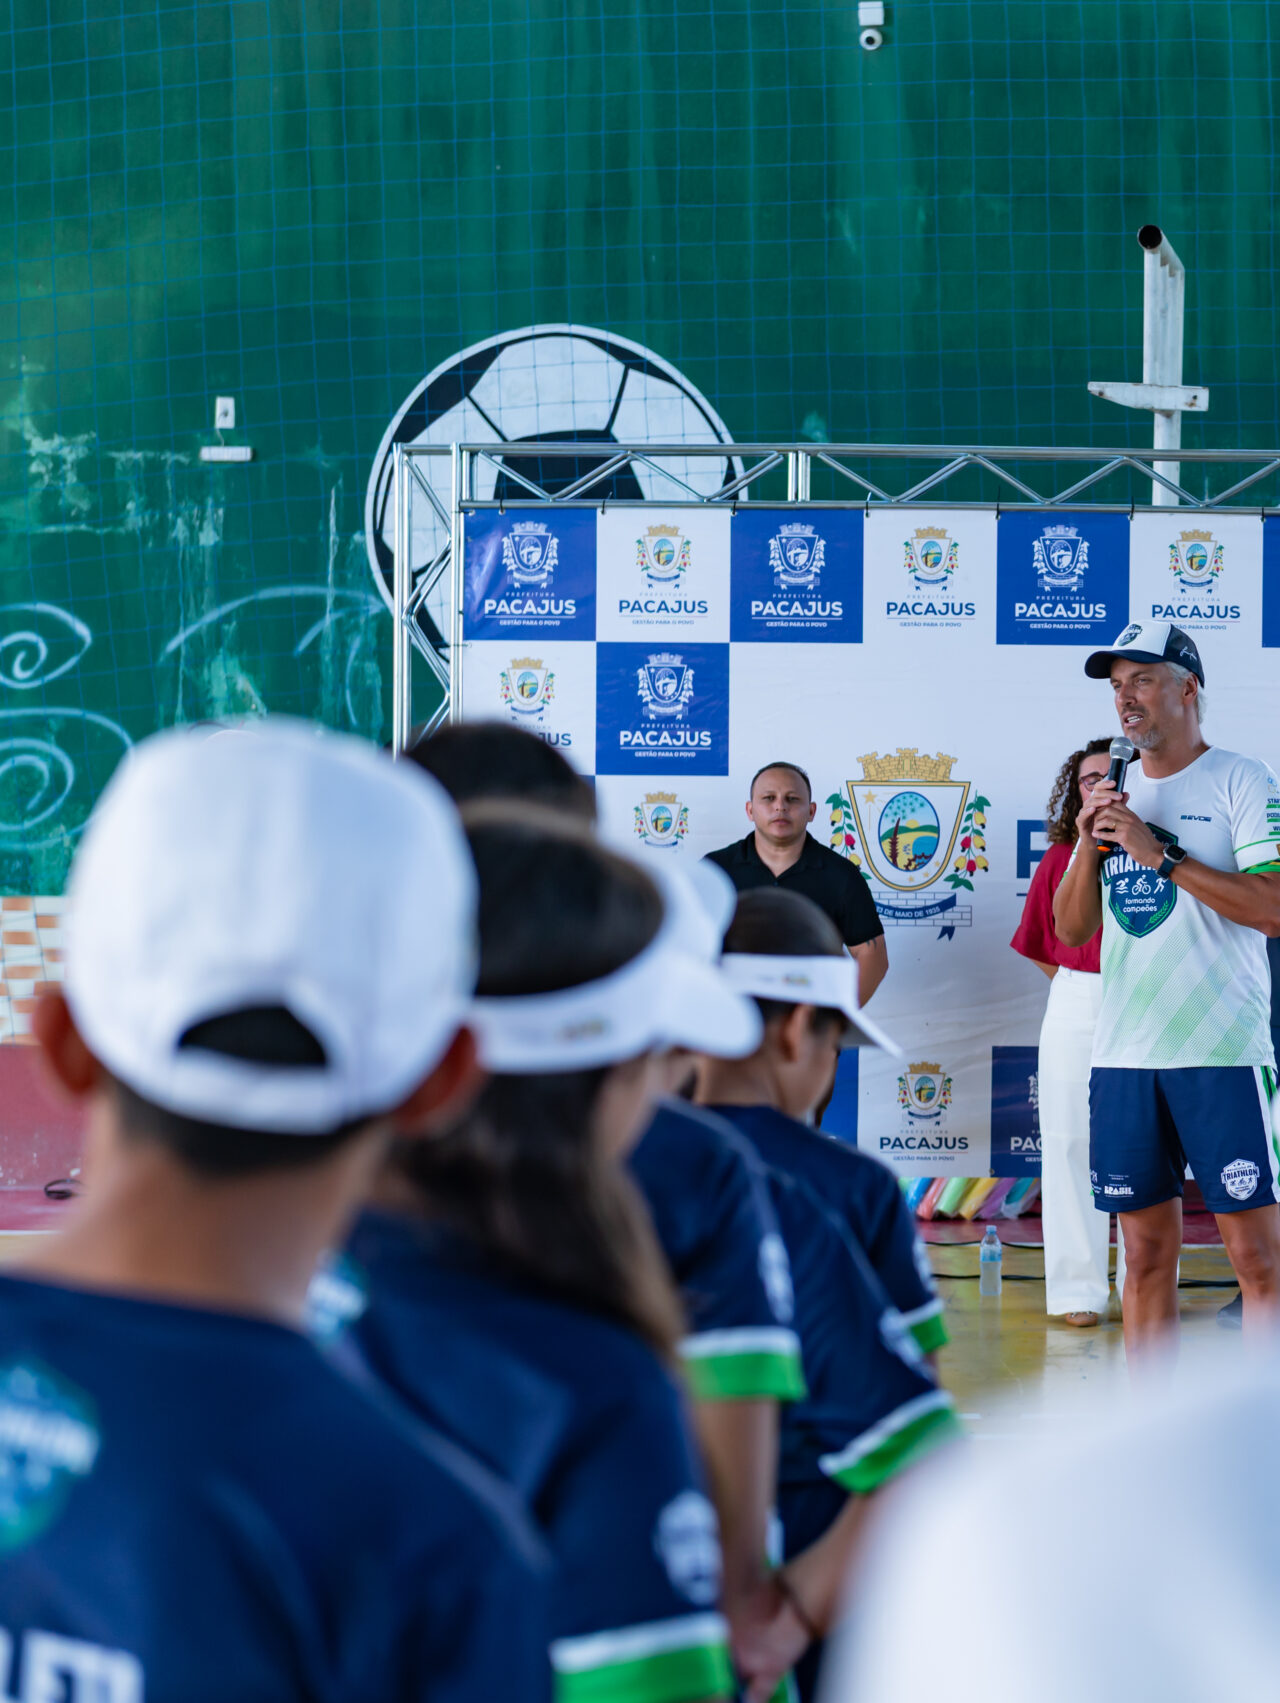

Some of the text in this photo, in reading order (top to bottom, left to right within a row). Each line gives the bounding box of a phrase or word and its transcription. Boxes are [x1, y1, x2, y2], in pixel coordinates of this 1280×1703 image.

[485, 600, 575, 614] PACAJUS
[619, 600, 708, 613] PACAJUS
[752, 601, 842, 616] PACAJUS
[887, 602, 975, 615] PACAJUS
[1015, 603, 1106, 618] PACAJUS
[1152, 605, 1241, 618] PACAJUS
[620, 731, 710, 746] PACAJUS
[1123, 905, 1157, 913] campeões
[880, 1137, 968, 1150] PACAJUS
[1223, 1168, 1257, 1181] TRIATHLON
